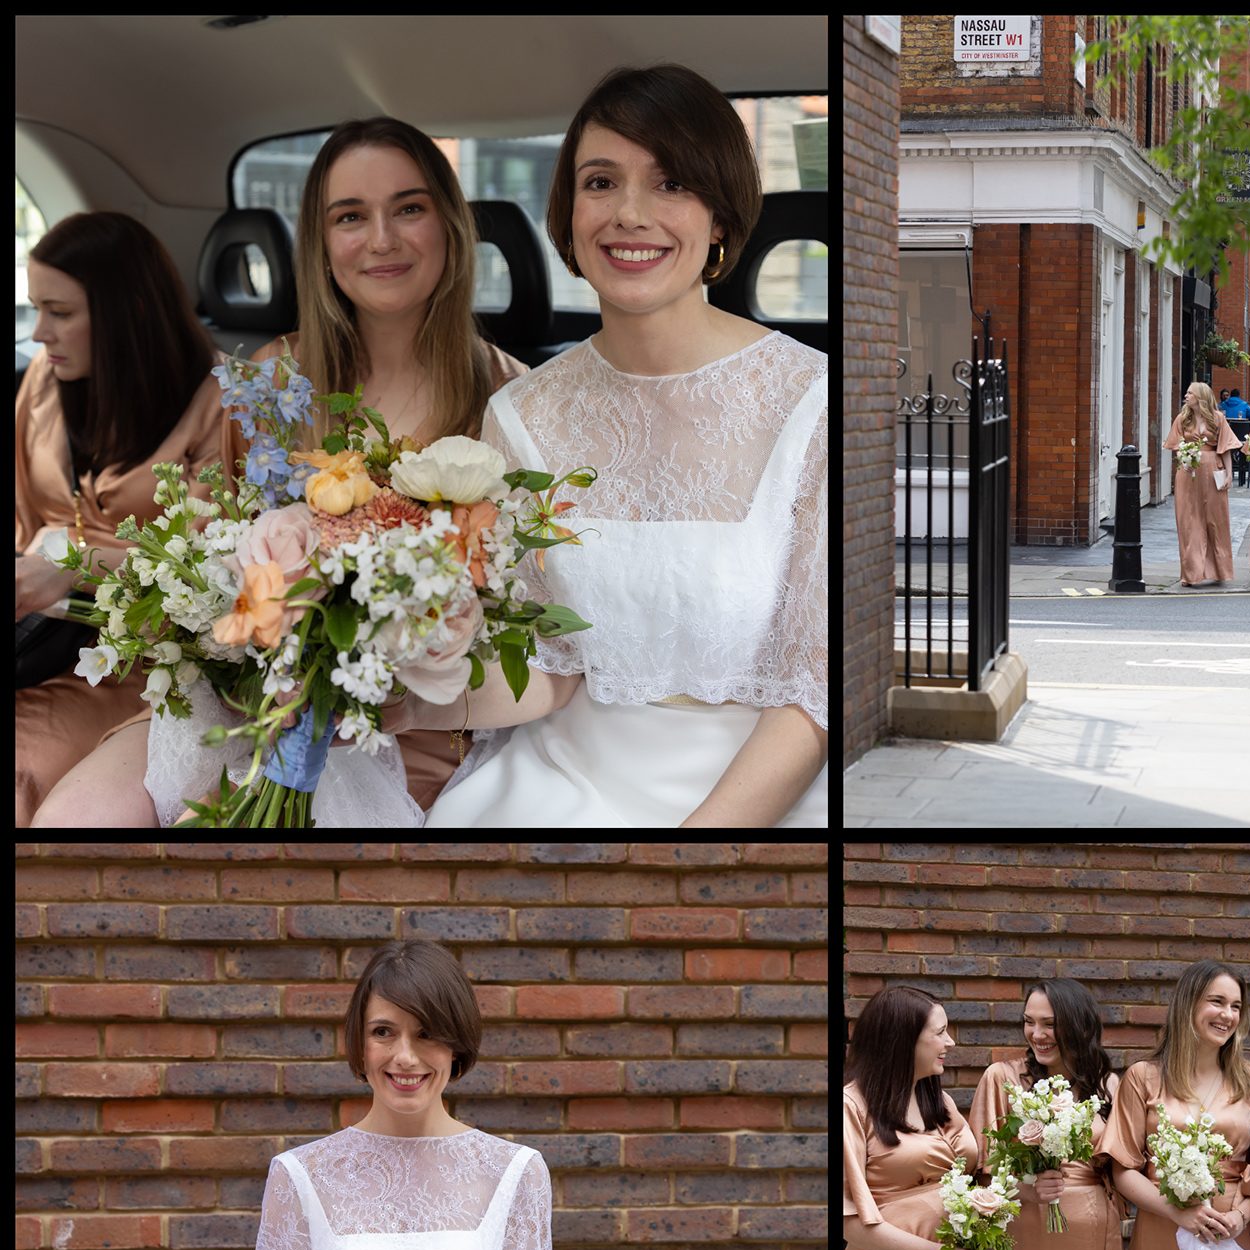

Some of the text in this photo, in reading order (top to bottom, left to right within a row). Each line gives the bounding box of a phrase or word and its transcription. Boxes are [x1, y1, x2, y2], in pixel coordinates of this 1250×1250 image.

[961, 20, 1006, 31] NASSAU
[961, 34, 1023, 46] STREET W1
